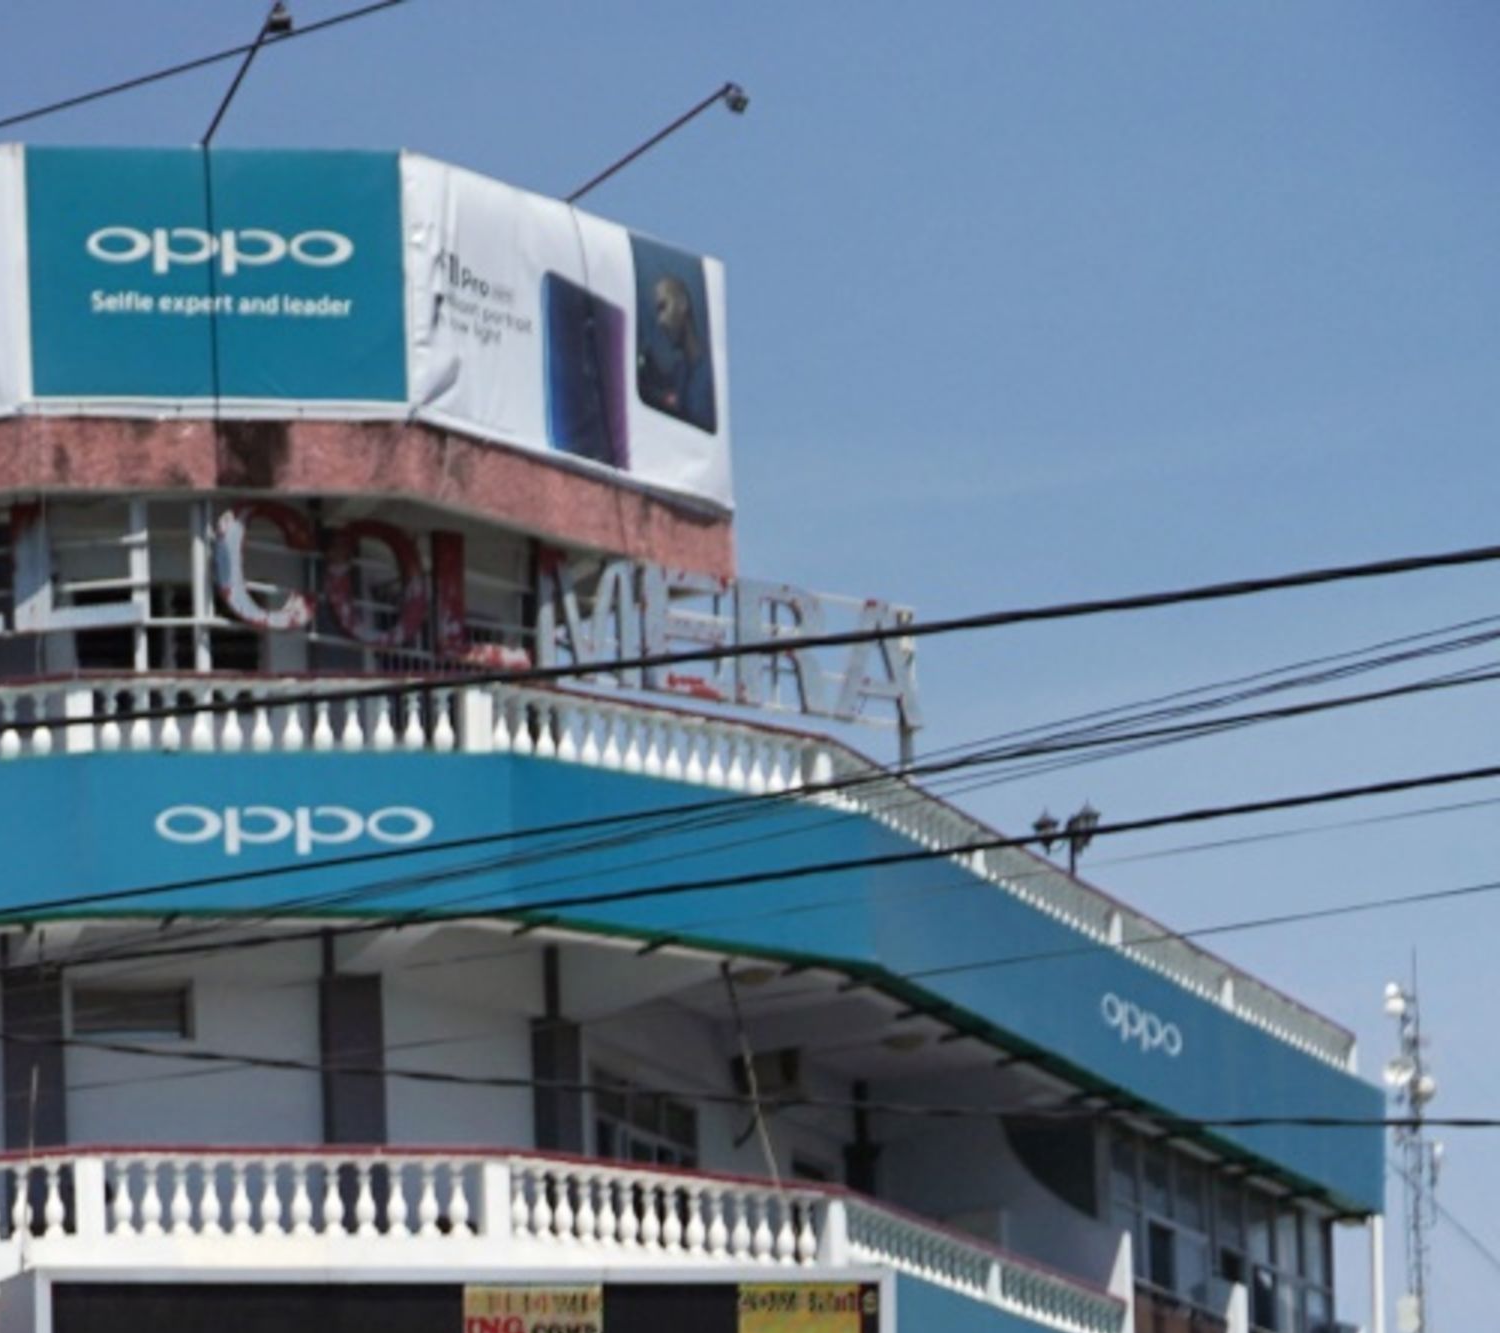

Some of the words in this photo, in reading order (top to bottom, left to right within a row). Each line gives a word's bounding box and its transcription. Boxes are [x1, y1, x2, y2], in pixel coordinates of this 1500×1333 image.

[86, 226, 355, 275] oppo
[92, 291, 154, 313] Selfie
[158, 293, 233, 316] expert
[238, 294, 280, 315] and
[283, 294, 353, 316] leader
[154, 804, 434, 855] oppo
[1101, 991, 1183, 1057] oppo
